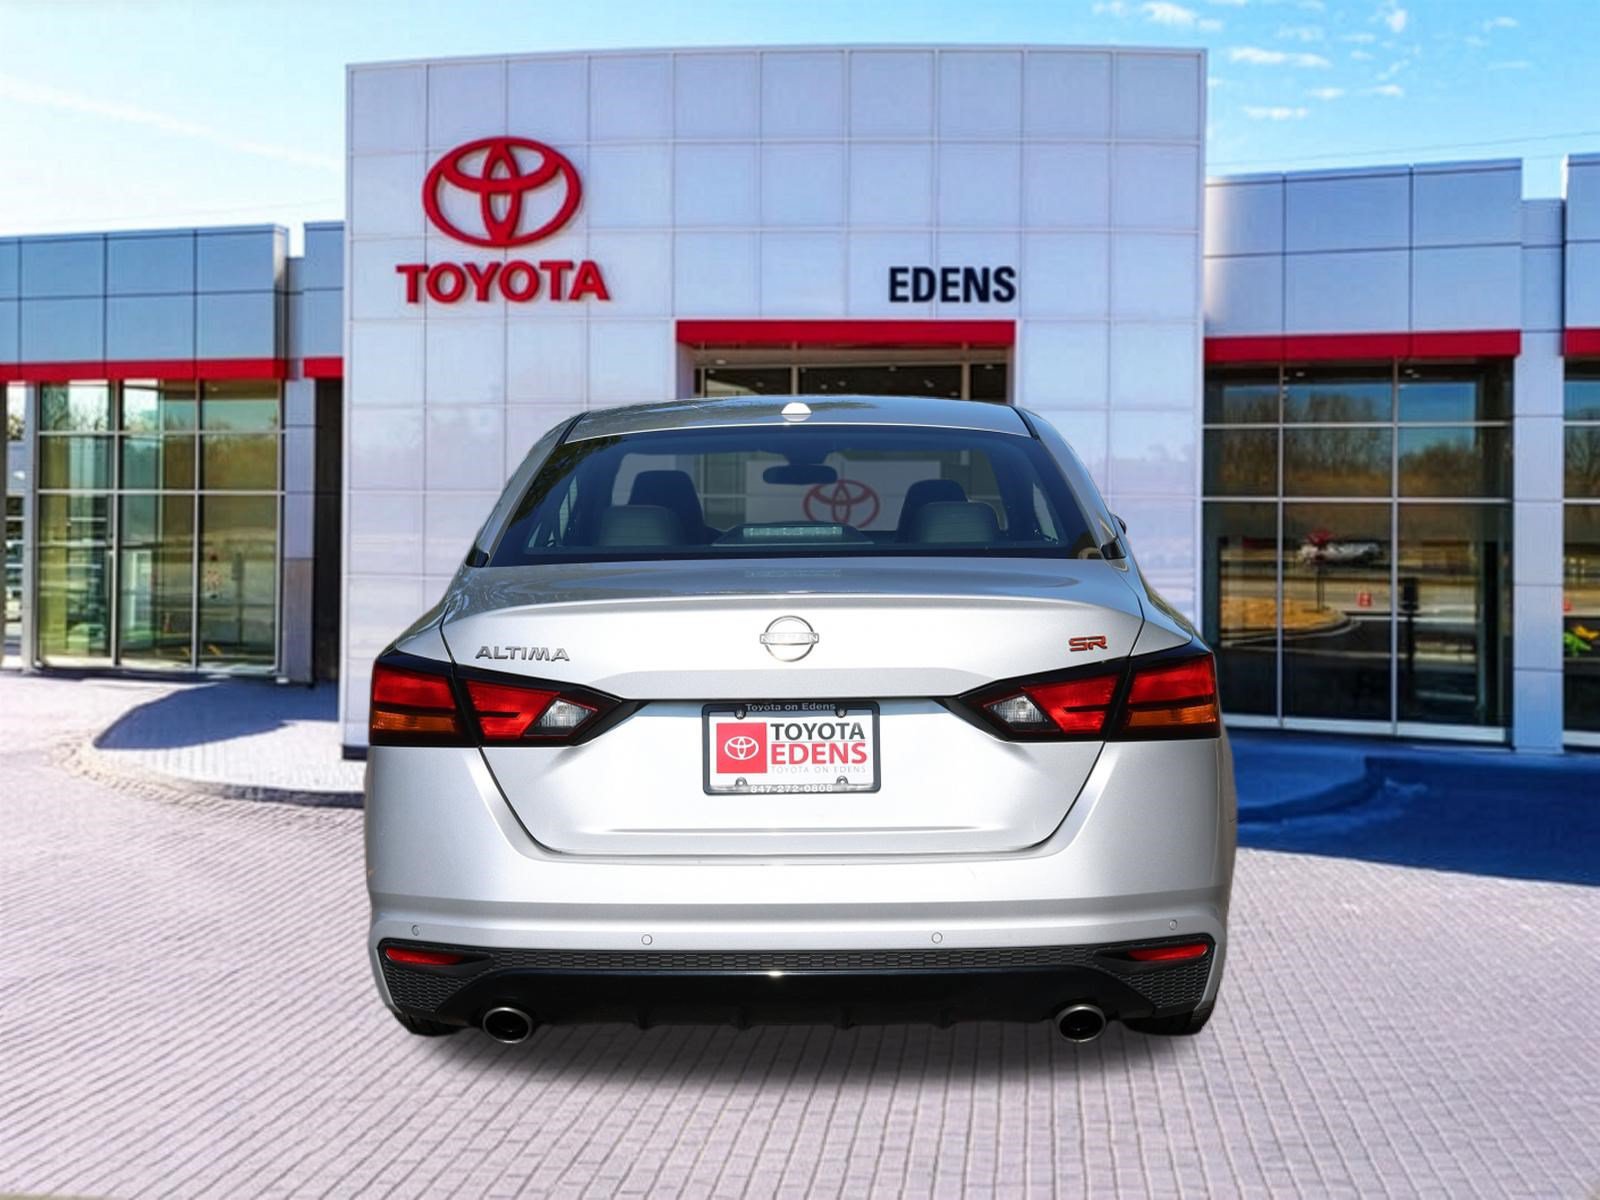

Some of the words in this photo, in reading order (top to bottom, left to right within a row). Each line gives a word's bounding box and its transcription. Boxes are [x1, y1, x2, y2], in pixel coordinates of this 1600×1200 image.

[396, 260, 611, 304] TOYOTA
[889, 266, 1016, 303] EDENS
[1068, 635, 1107, 652] SR
[475, 646, 570, 661] ALTIMA
[745, 703, 781, 712] Toyota
[801, 702, 836, 711] Edens
[770, 722, 865, 740] TOYOTA
[771, 742, 867, 765] EDENS
[771, 766, 809, 774] TOYOTA
[834, 765, 866, 773] EDENS
